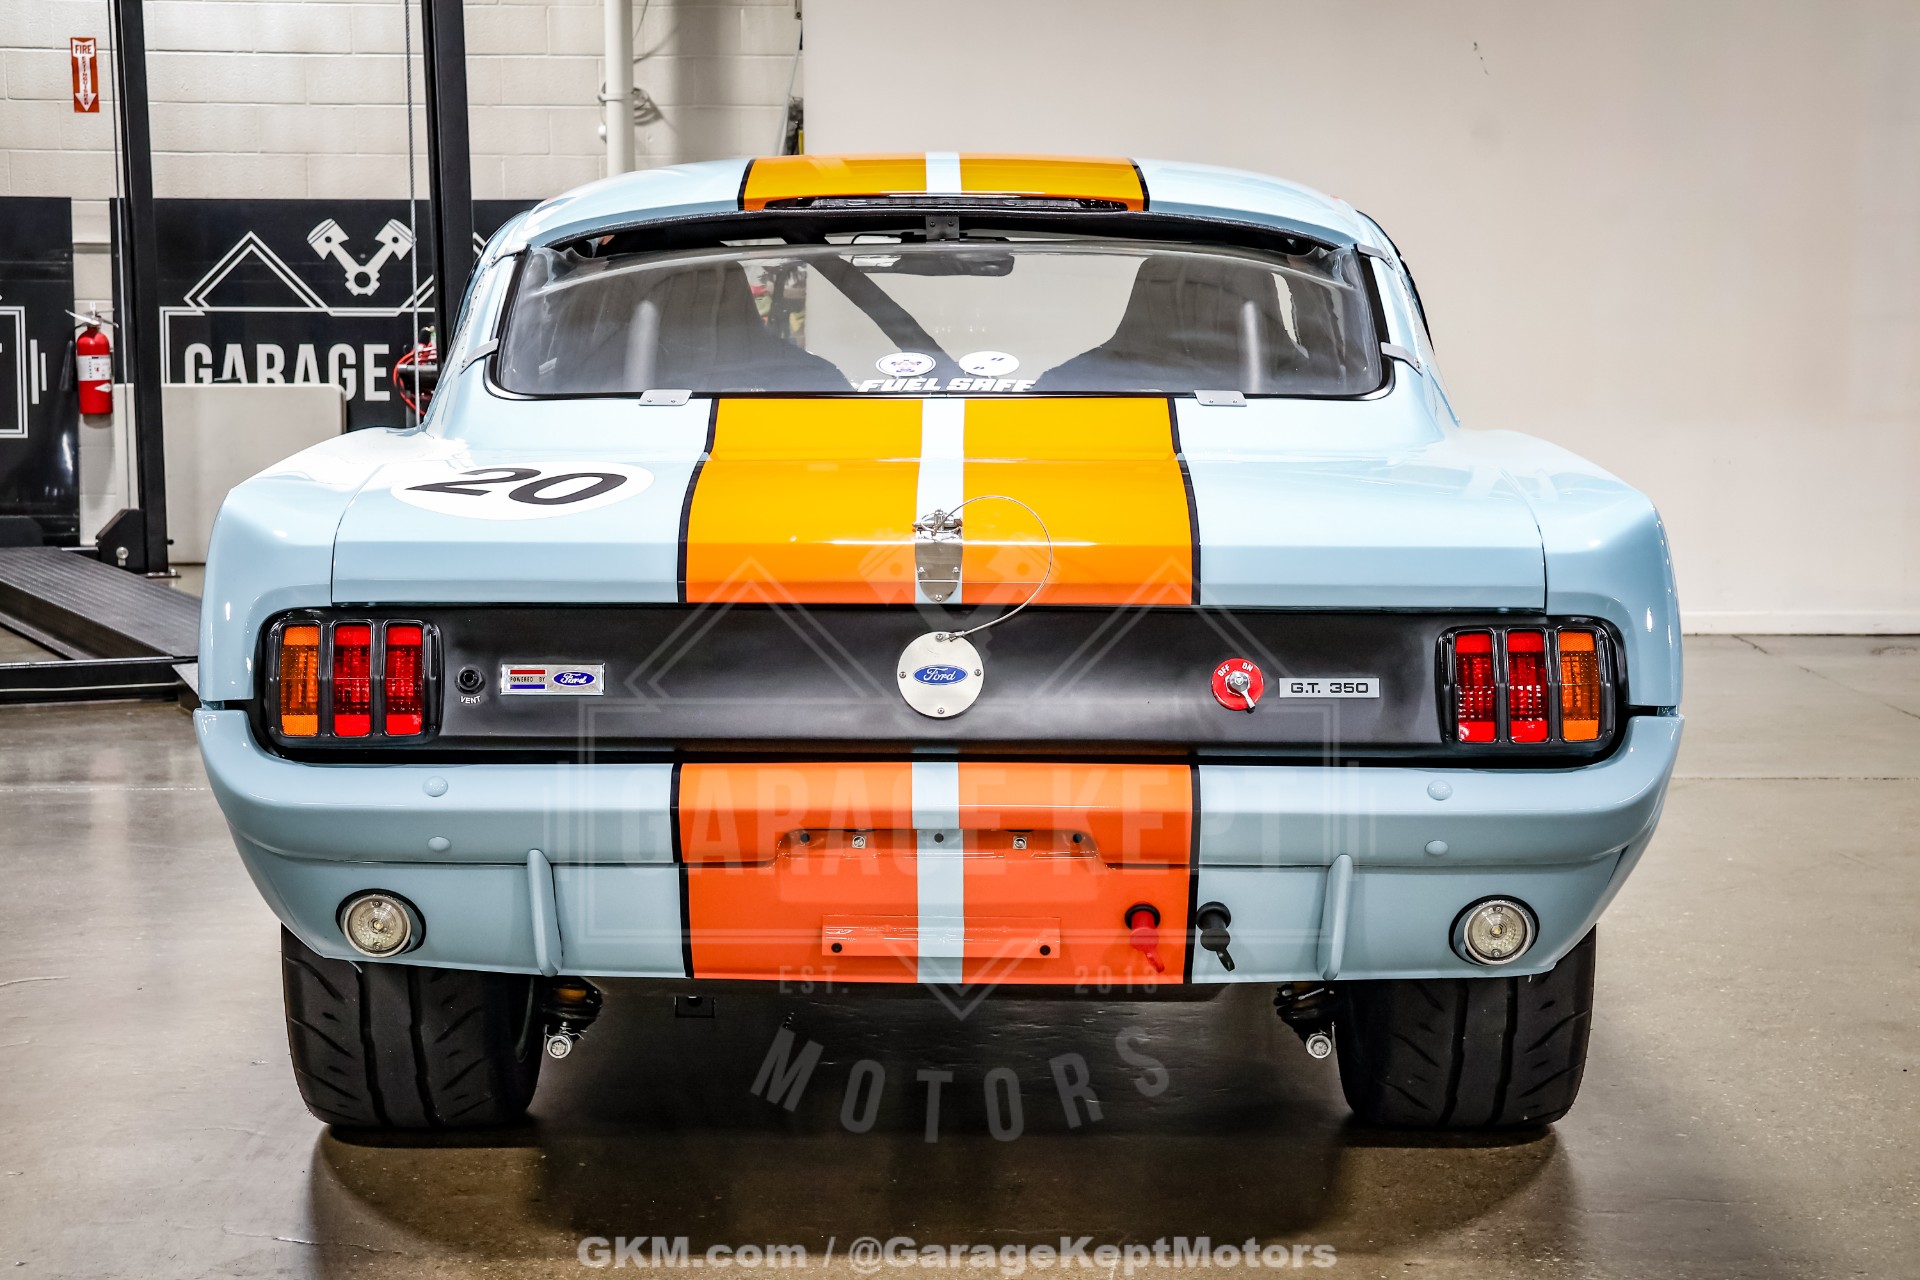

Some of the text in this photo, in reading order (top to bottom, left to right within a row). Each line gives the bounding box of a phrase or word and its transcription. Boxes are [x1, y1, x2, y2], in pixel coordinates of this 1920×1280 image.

[75, 45, 92, 54] FIRE
[184, 343, 390, 401] GARAGE
[857, 378, 1036, 392] FUEL SAFE
[404, 467, 628, 506] 20
[1217, 663, 1230, 677] OFF
[1241, 662, 1254, 672] ON
[560, 672, 587, 684] Ford
[923, 667, 957, 681] Ford
[1290, 682, 1369, 694] G.T. 350
[460, 695, 481, 704] VENT
